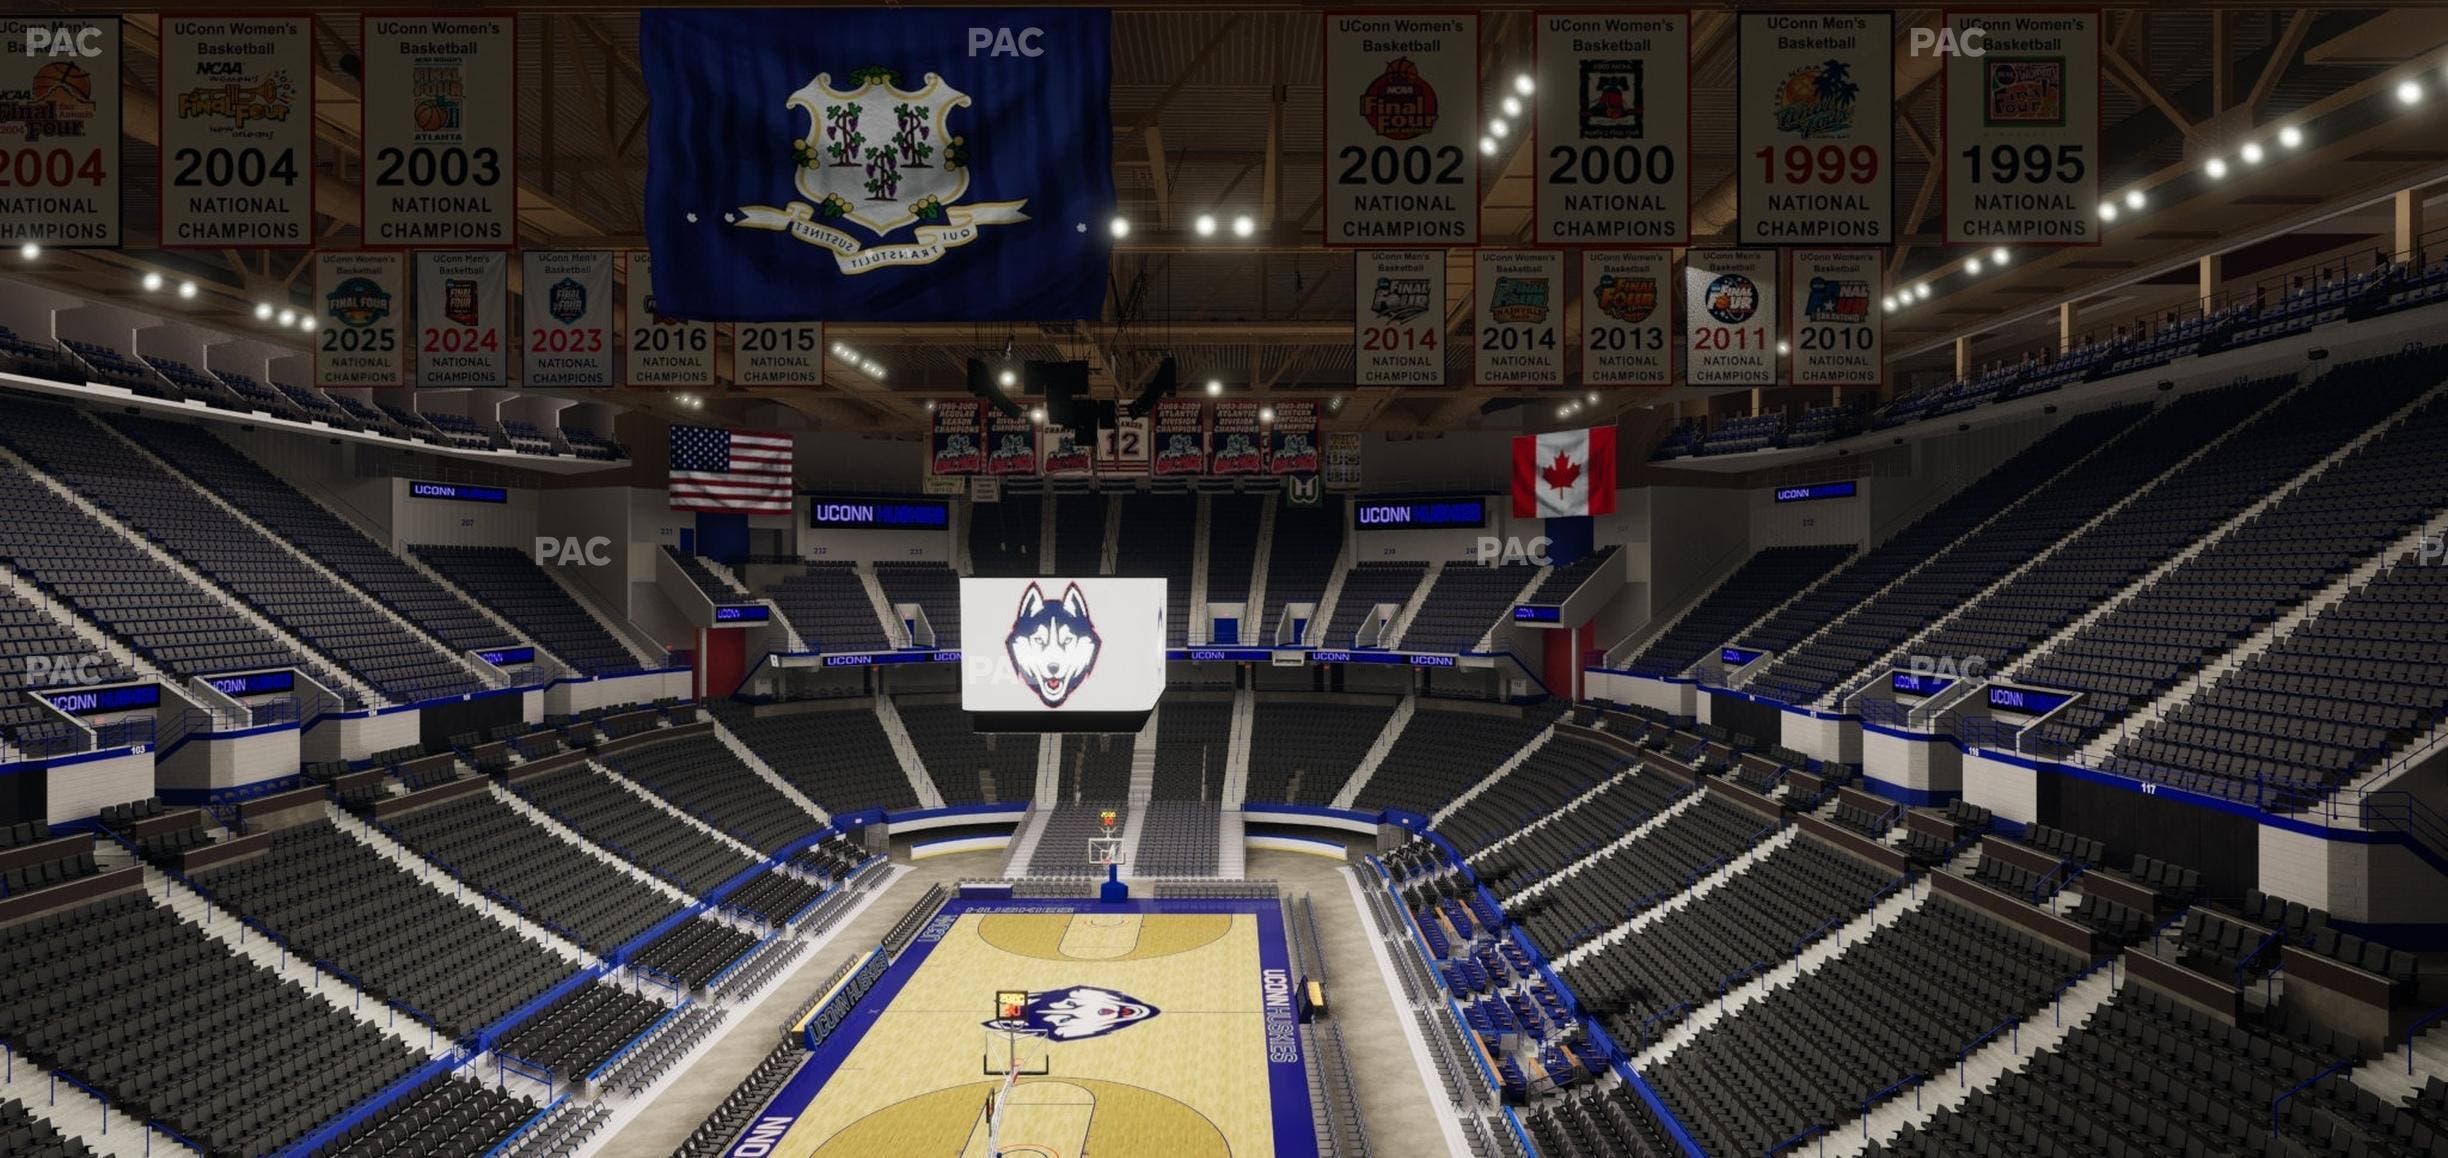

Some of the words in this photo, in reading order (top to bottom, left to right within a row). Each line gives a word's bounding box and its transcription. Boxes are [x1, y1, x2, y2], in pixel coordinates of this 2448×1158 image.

[52, 22, 94, 34] Men's
[175, 23, 224, 35] UConn
[229, 23, 297, 35] Women's
[377, 22, 427, 34] UConn
[432, 22, 500, 34] Women's
[1339, 20, 1389, 32] UConn
[1396, 20, 1463, 32] Women's
[1550, 20, 1600, 32] UConn
[1606, 20, 1674, 32] Women's
[1767, 18, 1817, 30] UConn
[1823, 18, 1866, 30] Men's
[1960, 19, 2010, 31] UConn
[2016, 19, 2084, 31] Women's
[198, 42, 275, 54] Basketball
[400, 42, 477, 54] Basketball
[1363, 39, 1440, 52] Basketball
[1573, 39, 1650, 52] Basketball
[1778, 37, 1855, 49] Basketball
[1983, 38, 2060, 51] Basketball
[197, 62, 242, 74] NCAA
[1361, 95, 1424, 115] Final
[1377, 114, 1439, 136] Four
[174, 148, 298, 187] 2004
[377, 148, 500, 187] 2003
[1339, 146, 1464, 184] 2002
[1549, 146, 1674, 184] 2000
[1757, 145, 1878, 184] 1999
[1963, 145, 2084, 184] 1995
[0, 198, 97, 213] NATIONAL
[190, 198, 289, 213] NATIONAL
[392, 198, 491, 213] NATIONAL
[1355, 196, 1455, 211] NATIONAL
[1565, 196, 1665, 211] NATIONAL
[1769, 196, 1870, 211] NATIONAL
[1975, 196, 2076, 211] NATIONAL
[0, 223, 107, 238] HAMPIONS
[178, 223, 299, 238] CHAMPIONS
[381, 223, 501, 238] CHAMPIONS
[1343, 221, 1465, 236] CHAMPIONS
[1554, 221, 1675, 236] CHAMPIONS
[1757, 221, 1879, 236] CHAMPIONS
[1963, 221, 2085, 236] CHAMPIONS
[433, 255, 463, 263] UConn
[545, 266, 591, 274] Basketball
[322, 329, 394, 351] 2025
[424, 329, 497, 352] 2024
[531, 329, 602, 352] 2023
[634, 328, 707, 350] 2016
[742, 328, 814, 350] 2015
[1363, 328, 1437, 350] 2014
[1483, 328, 1555, 350] 2014
[1590, 328, 1663, 350] 2013
[1695, 328, 1766, 350] 2011
[1800, 328, 1873, 350] 2010
[331, 358, 390, 367] NATIONAL
[432, 358, 491, 367] NATIONAL
[538, 358, 597, 368] NATIONAL
[643, 357, 702, 367] NATIONAL
[751, 357, 809, 367] NATIONAL
[1373, 357, 1431, 366] NATIONAL
[1491, 357, 1550, 366] NATIONAL
[1600, 357, 1658, 366] NATIONAL
[1704, 357, 1763, 366] NATIONAL
[1809, 357, 1867, 366] NATIONAL
[325, 373, 396, 382] CHAMPIONS
[428, 372, 495, 382] CHAMPIONS
[533, 373, 602, 383] CHAMPIONS
[636, 372, 707, 382] CHAMPIONS
[744, 372, 815, 382] CHAMPIONS
[1366, 372, 1437, 381] CHAMPIONS
[1485, 372, 1556, 381] CHAMPIONS
[1593, 372, 1664, 381] CHAMPIONS
[1697, 372, 1769, 381] CHAMPIONS
[1803, 372, 1874, 381] CHAMPIONS
[414, 485, 455, 497] UCONN
[1778, 489, 1809, 500] UCONN
[816, 505, 873, 522] UCONN
[1359, 507, 1410, 524] UCONN
[827, 656, 872, 666] UCONN
[934, 652, 962, 661] UCON
[1192, 652, 1225, 660] UCONN
[1312, 652, 1349, 661] UCONN
[1410, 656, 1453, 666] UCONN
[1991, 690, 2023, 707] UCONN
[131, 745, 146, 755] 103
[2141, 783, 2156, 795] 117
[1263, 969, 1290, 1006] UCONN
[810, 990, 848, 1046] UCONN
[1266, 1007, 1298, 1063] HUSKIES
[734, 1117, 794, 1157] ONN
